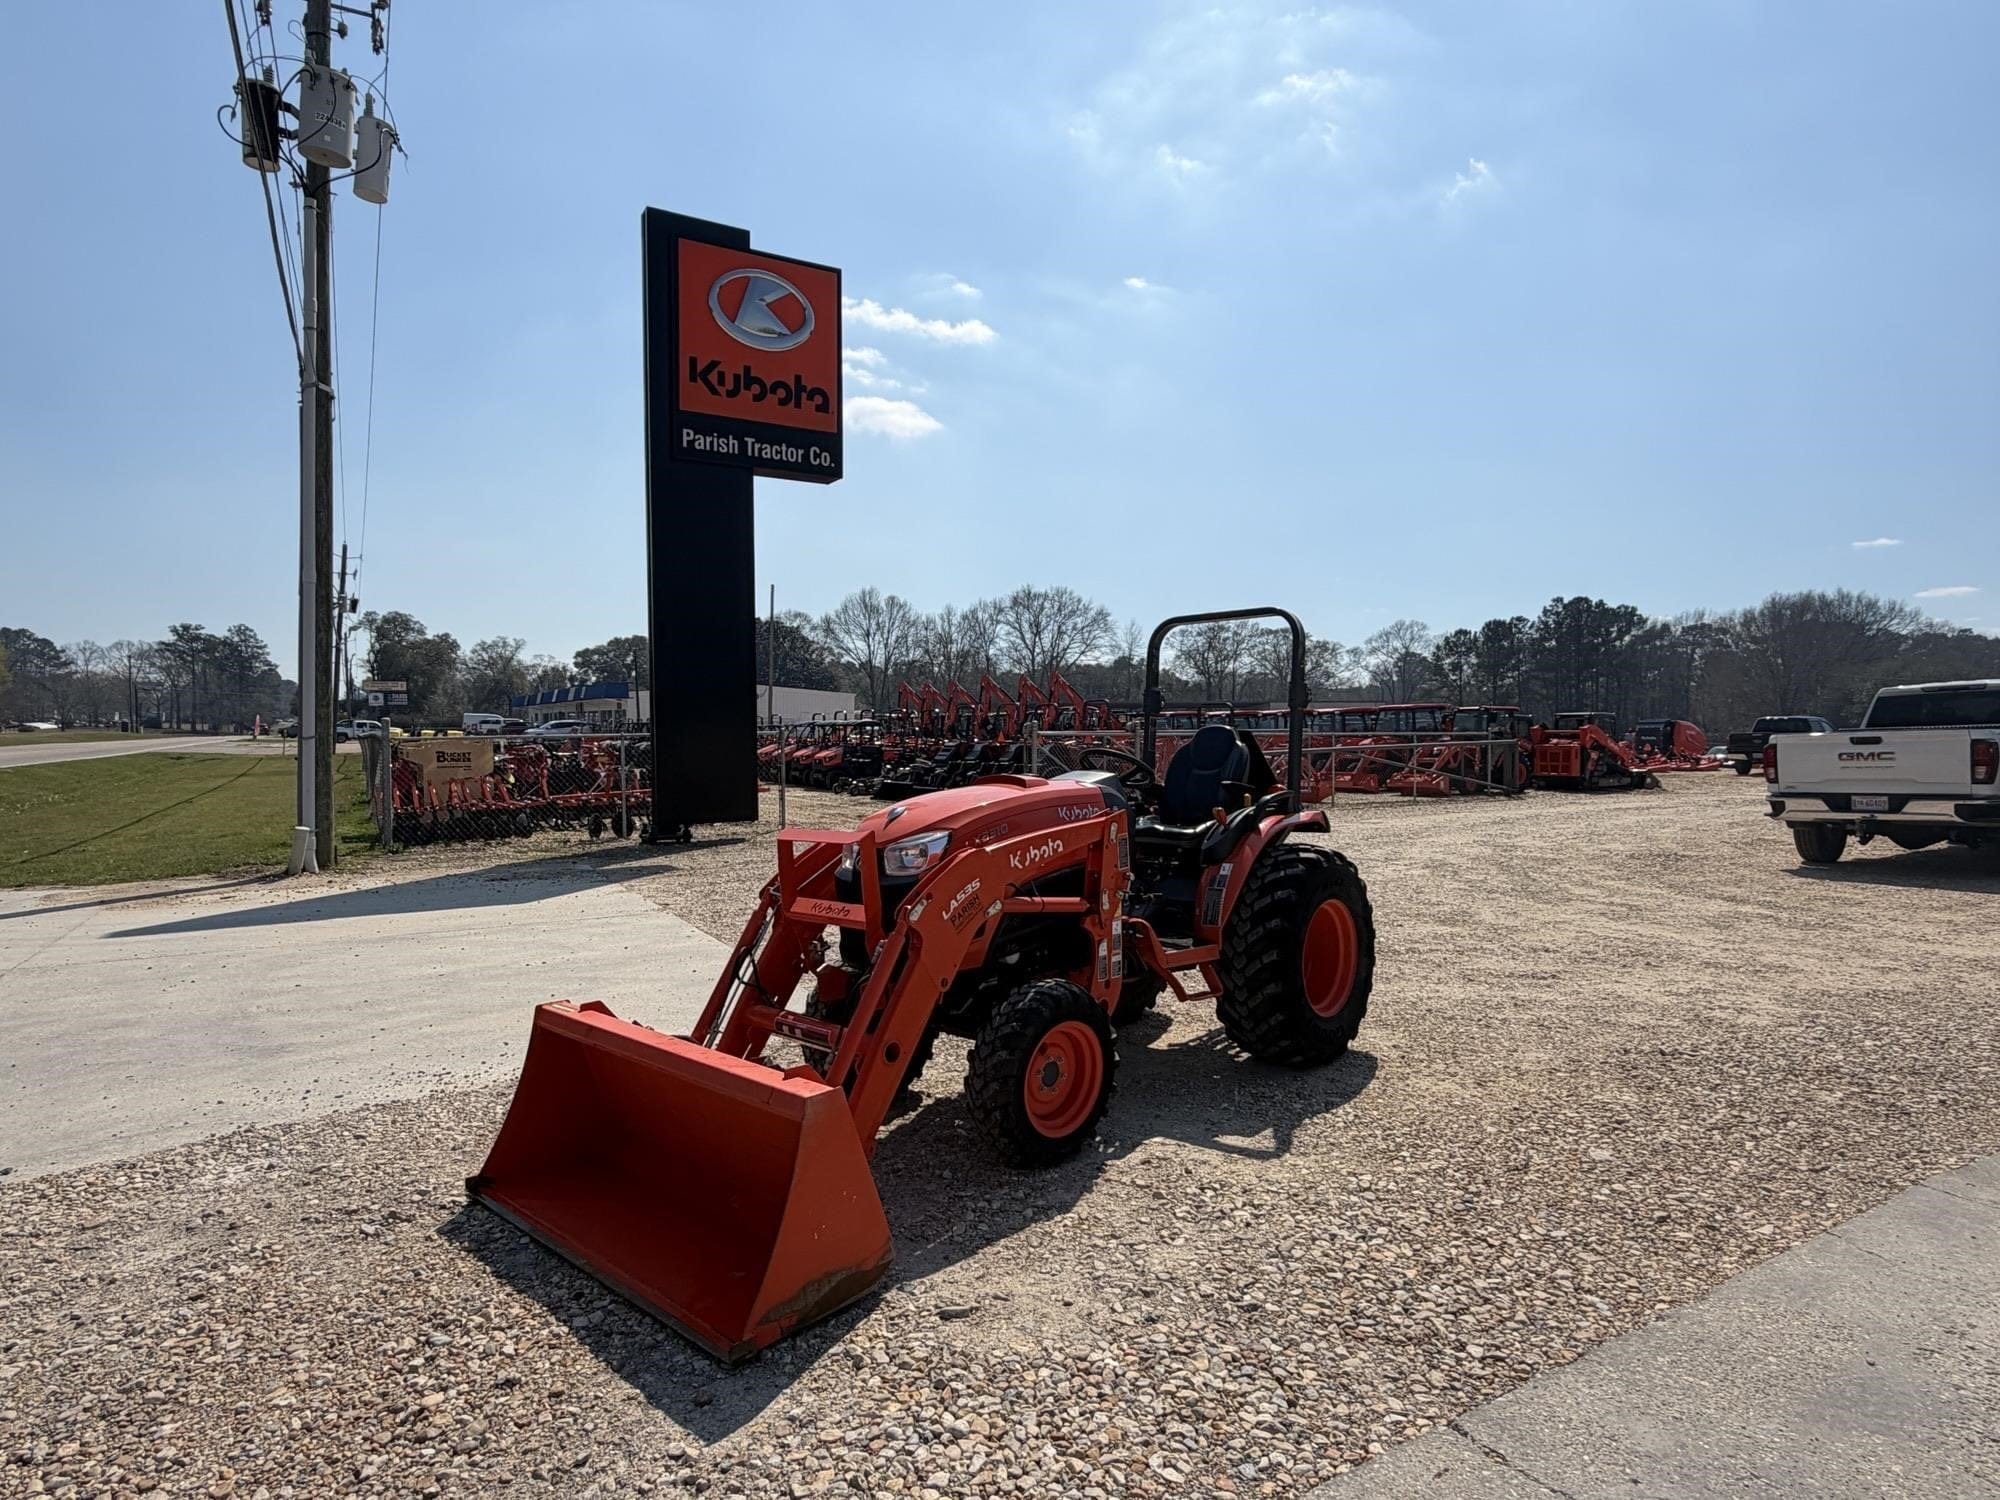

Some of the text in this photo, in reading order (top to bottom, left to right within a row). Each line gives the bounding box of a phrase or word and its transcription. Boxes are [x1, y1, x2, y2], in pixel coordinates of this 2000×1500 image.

[688, 355, 831, 415] Kubota
[682, 428, 835, 468] Parish Tractor Co.
[1838, 751, 1896, 761] GMC
[1009, 838, 1064, 869] Kubota
[810, 902, 850, 918] Kubota
[942, 878, 981, 920] LA535
